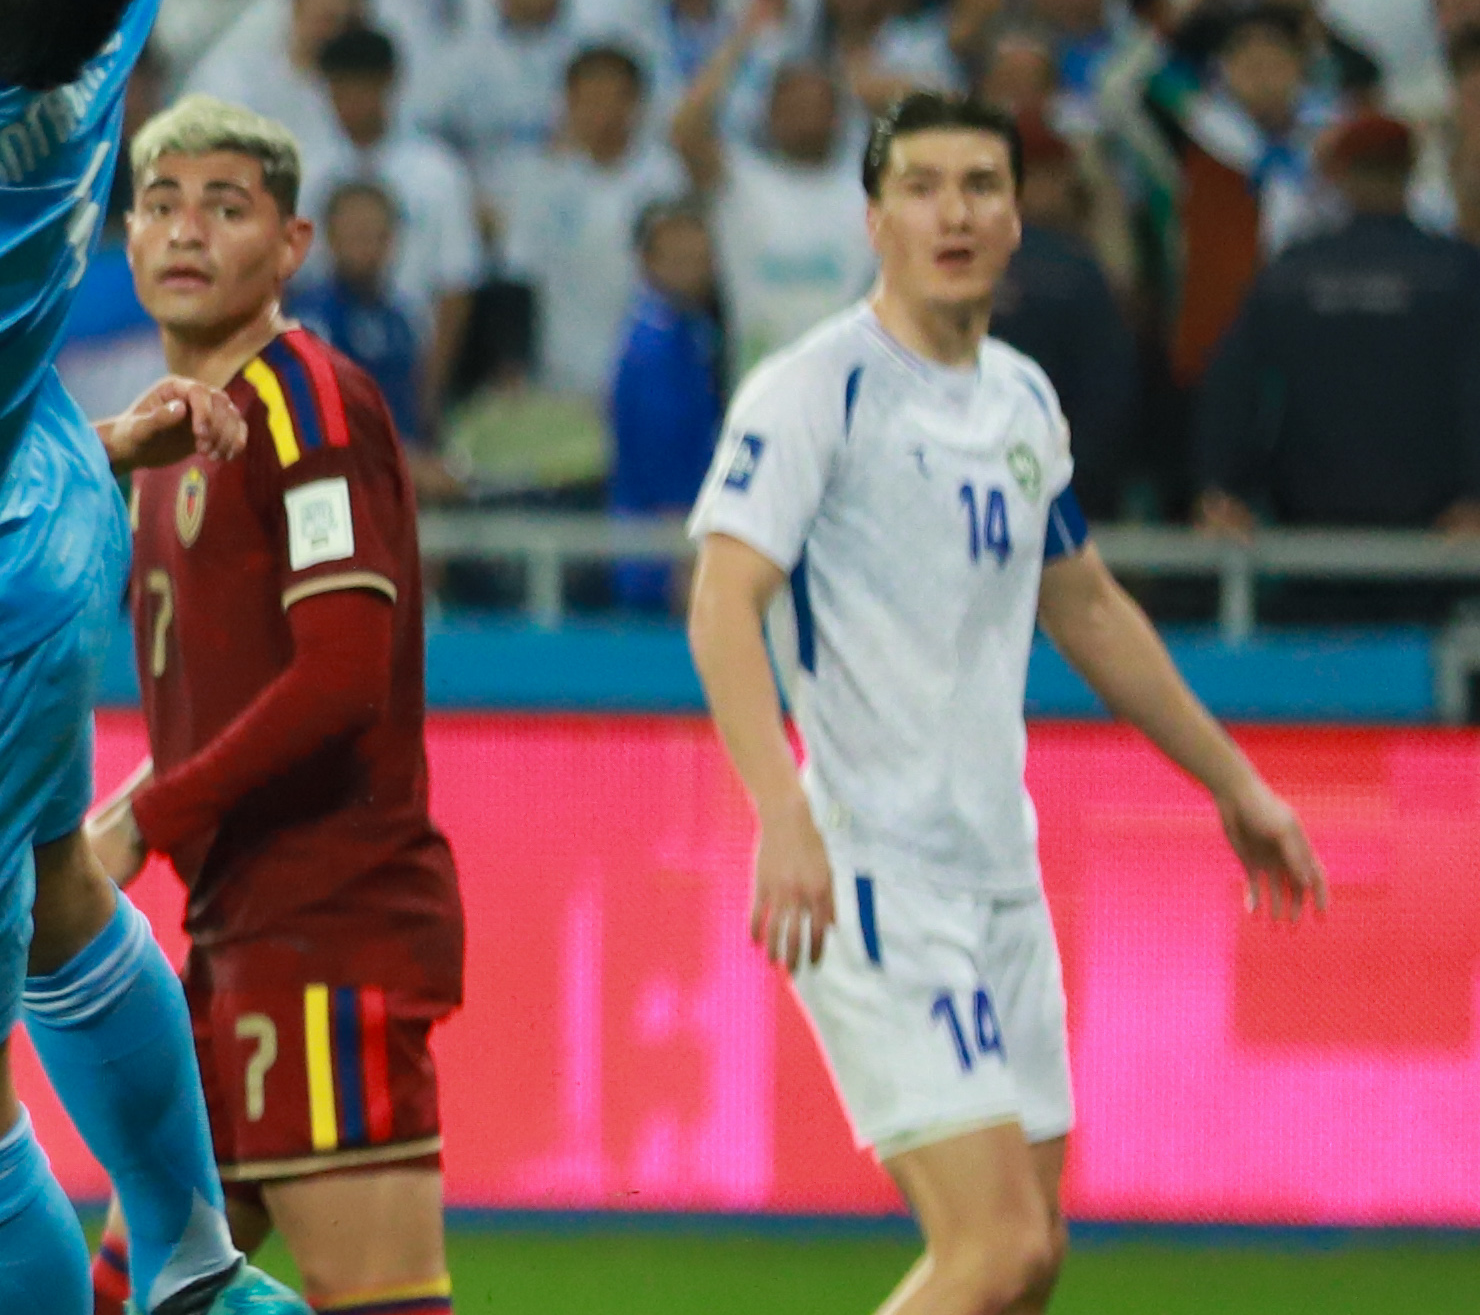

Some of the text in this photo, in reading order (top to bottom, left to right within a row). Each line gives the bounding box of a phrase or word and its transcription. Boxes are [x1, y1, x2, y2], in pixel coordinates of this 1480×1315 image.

[959, 478, 1012, 571] 14
[235, 1012, 278, 1122] 7
[930, 984, 1008, 1072] 14
